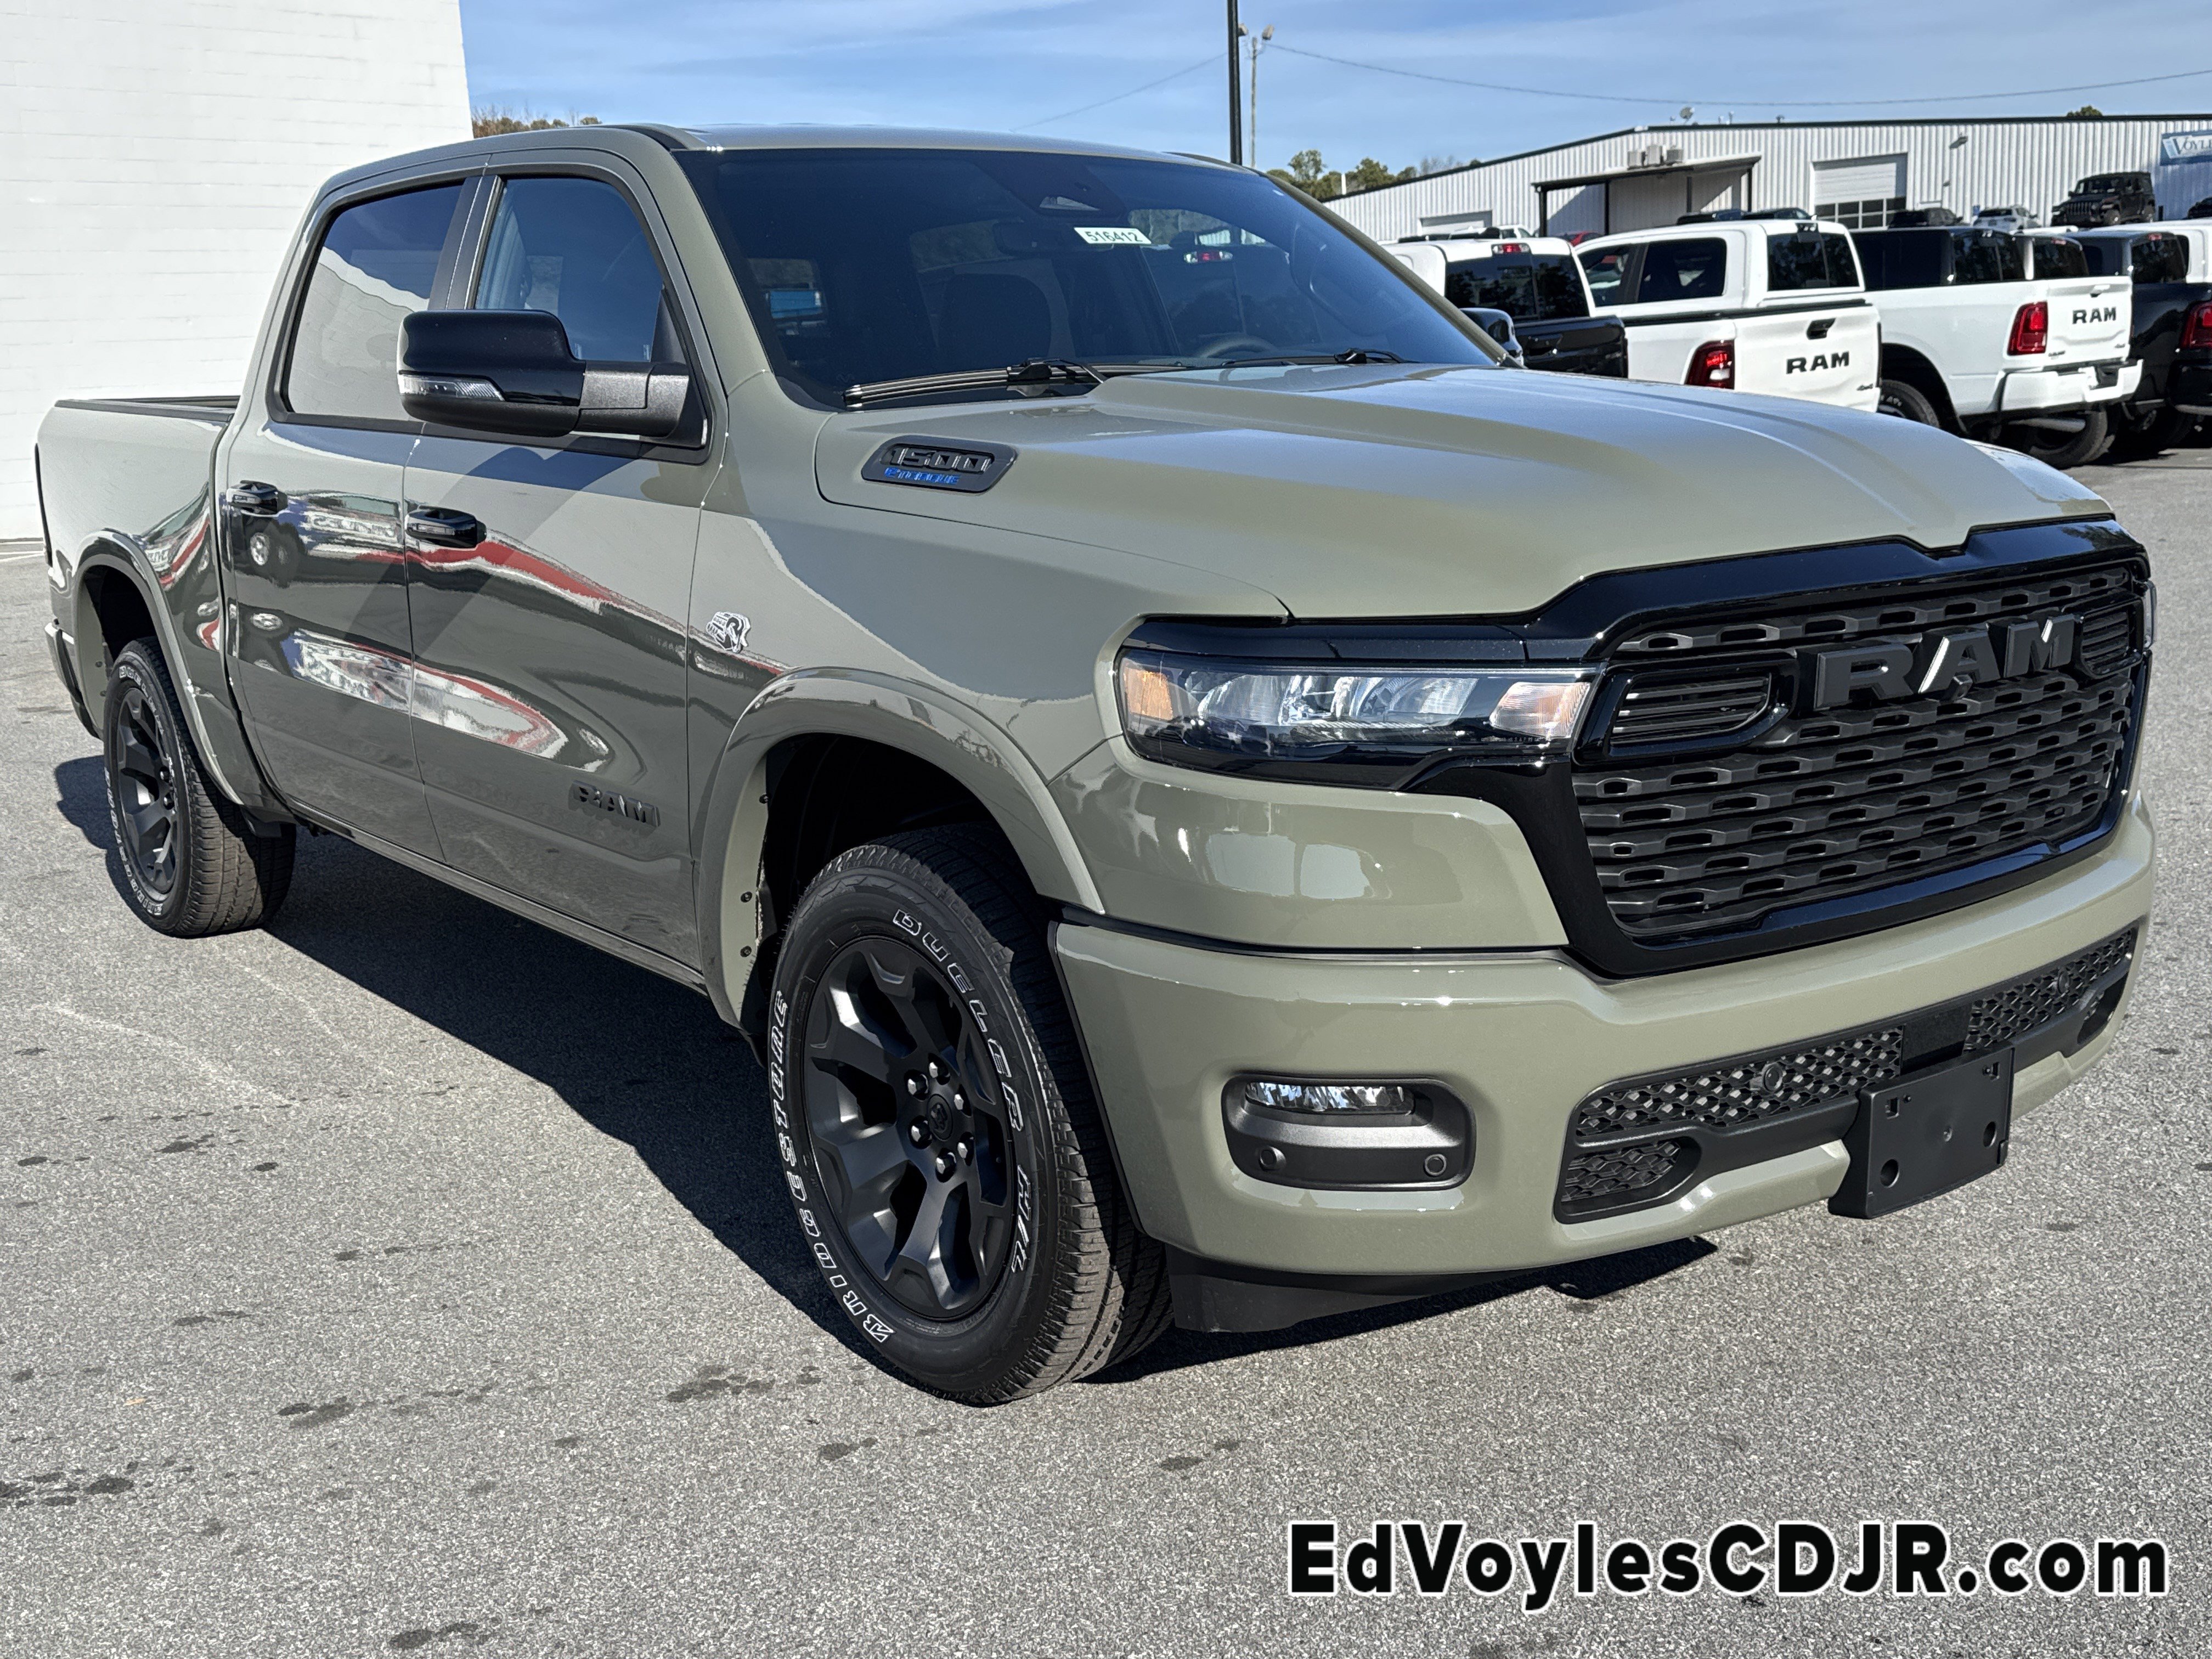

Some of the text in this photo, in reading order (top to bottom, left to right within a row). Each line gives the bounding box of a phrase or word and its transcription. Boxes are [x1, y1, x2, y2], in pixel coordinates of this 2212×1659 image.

[1085, 231, 1143, 242] 516412
[2072, 307, 2116, 324] RAM
[1786, 351, 1849, 374] RAM
[881, 443, 994, 474] 1500
[1812, 611, 2078, 712] RAM
[568, 779, 661, 827] RAM
[893, 909, 1024, 1132] DUELER
[771, 990, 896, 1343] BRIDGESTONE
